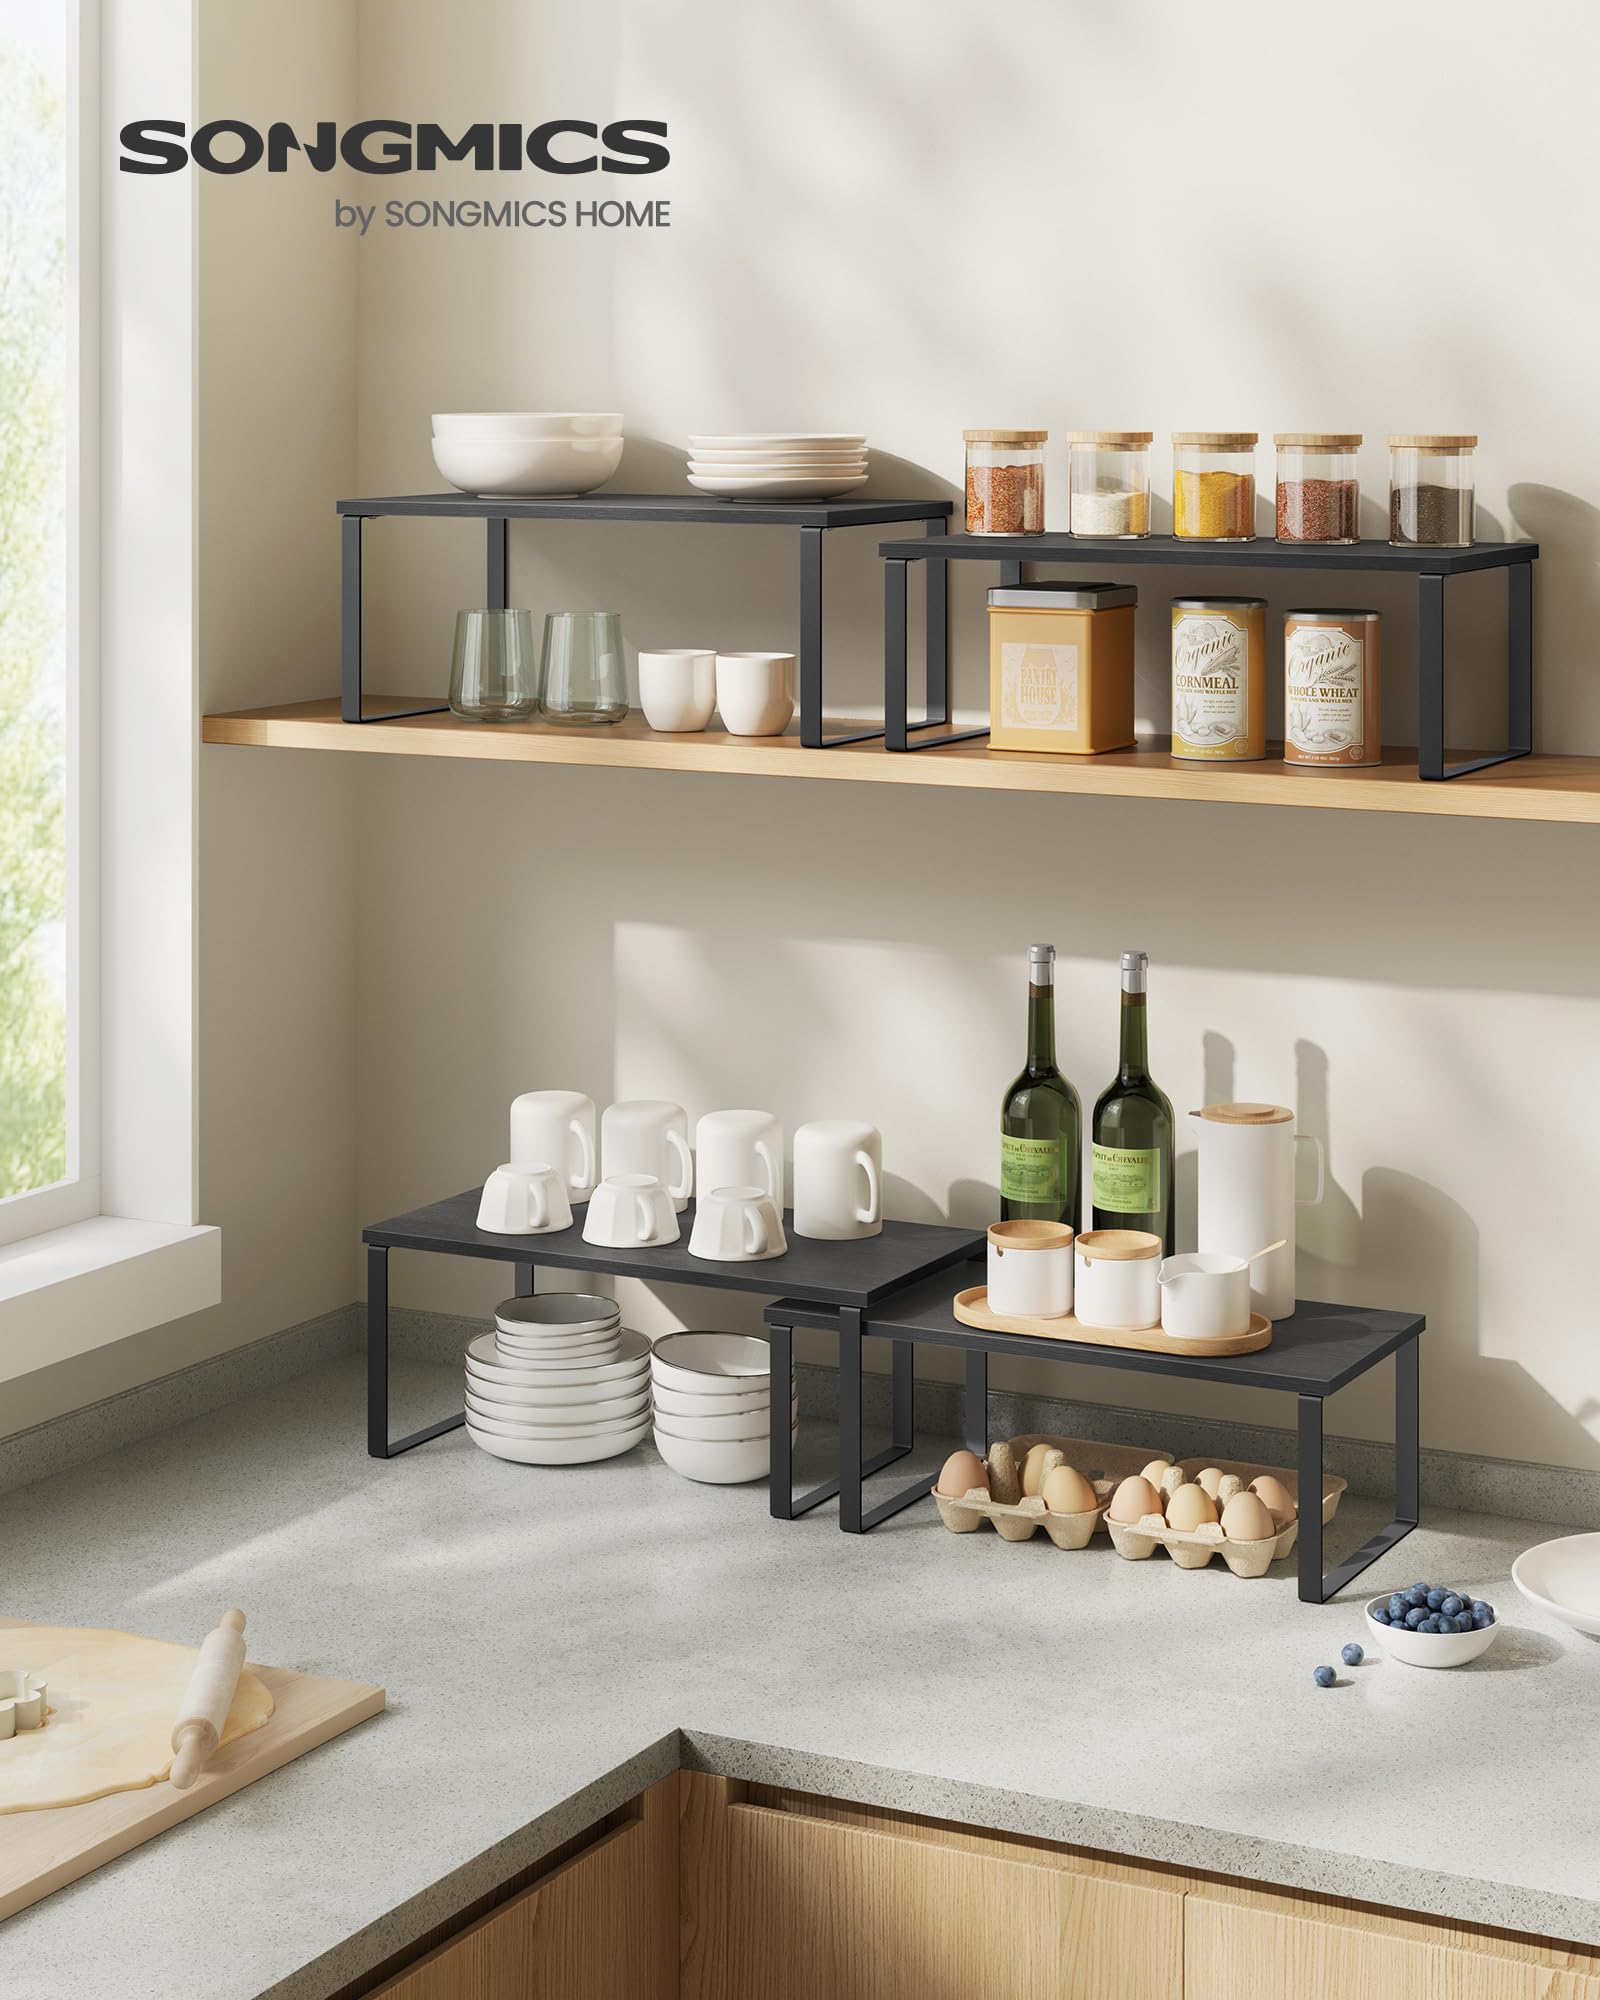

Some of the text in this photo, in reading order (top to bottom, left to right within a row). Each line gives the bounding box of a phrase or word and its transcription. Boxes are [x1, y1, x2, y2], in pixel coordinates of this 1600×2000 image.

[1175, 630, 1234, 670] Organic
[1288, 642, 1351, 681] Organic
[1176, 674, 1239, 689] CORNMEAL
[1021, 687, 1056, 704] HOUSE
[1288, 685, 1359, 698] WHOLE WHEAT
